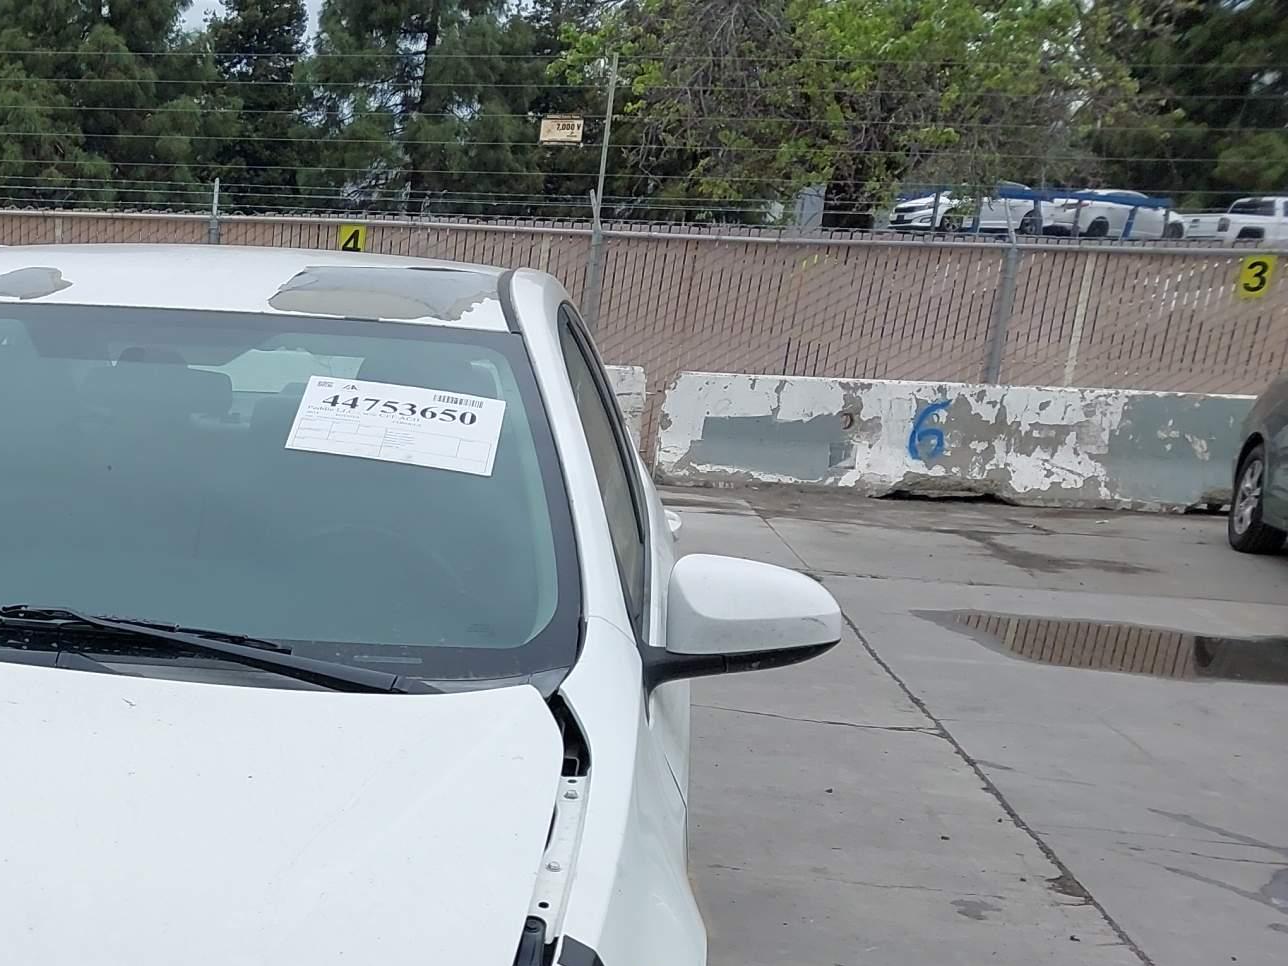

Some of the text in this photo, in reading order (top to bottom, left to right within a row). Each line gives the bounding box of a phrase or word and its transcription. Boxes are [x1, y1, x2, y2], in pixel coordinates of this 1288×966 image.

[342, 229, 362, 252] 4
[1243, 260, 1269, 293] 3
[321, 394, 478, 426] 44753650
[908, 398, 953, 461] 6
